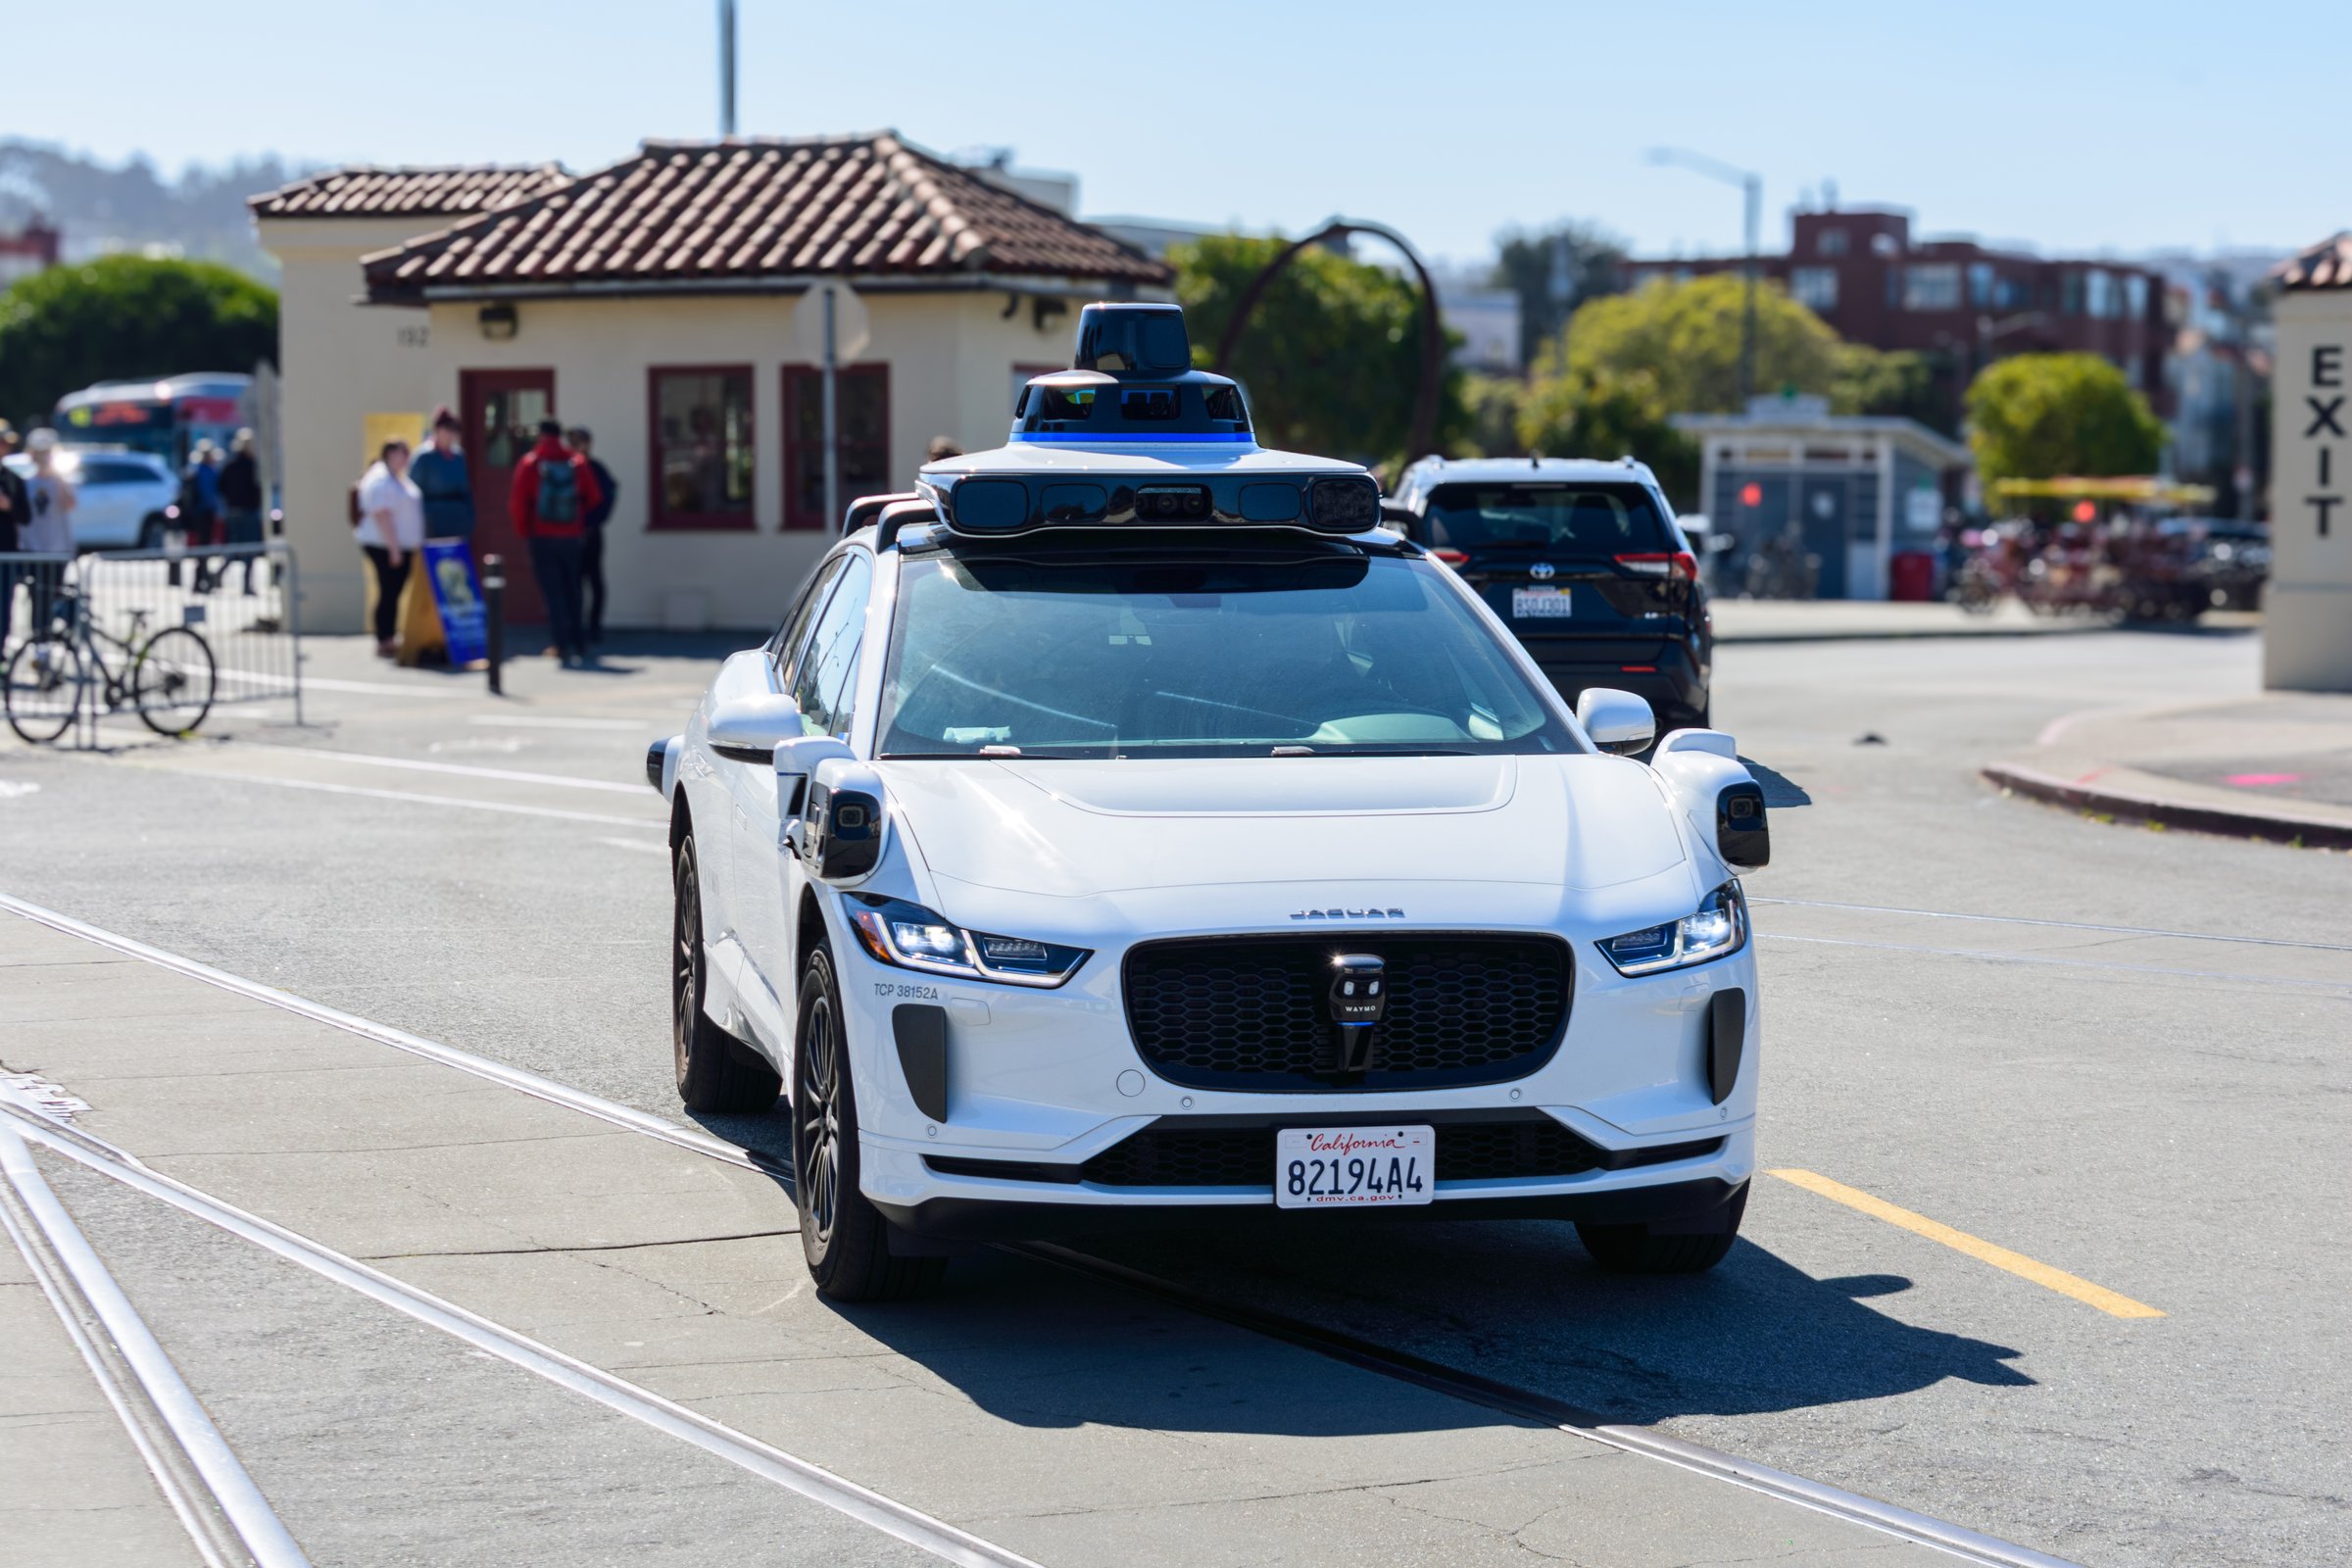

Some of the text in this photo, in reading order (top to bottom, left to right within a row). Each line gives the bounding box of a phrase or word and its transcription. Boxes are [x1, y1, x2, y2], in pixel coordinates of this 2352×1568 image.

[2303, 346, 2347, 538] EXIT
[874, 983, 939, 1000] TCP 38152A
[1310, 1133, 1406, 1156] California
[1288, 1156, 1423, 1196] 82194A4
[1316, 1194, 1395, 1202] dmv.ca.gov
